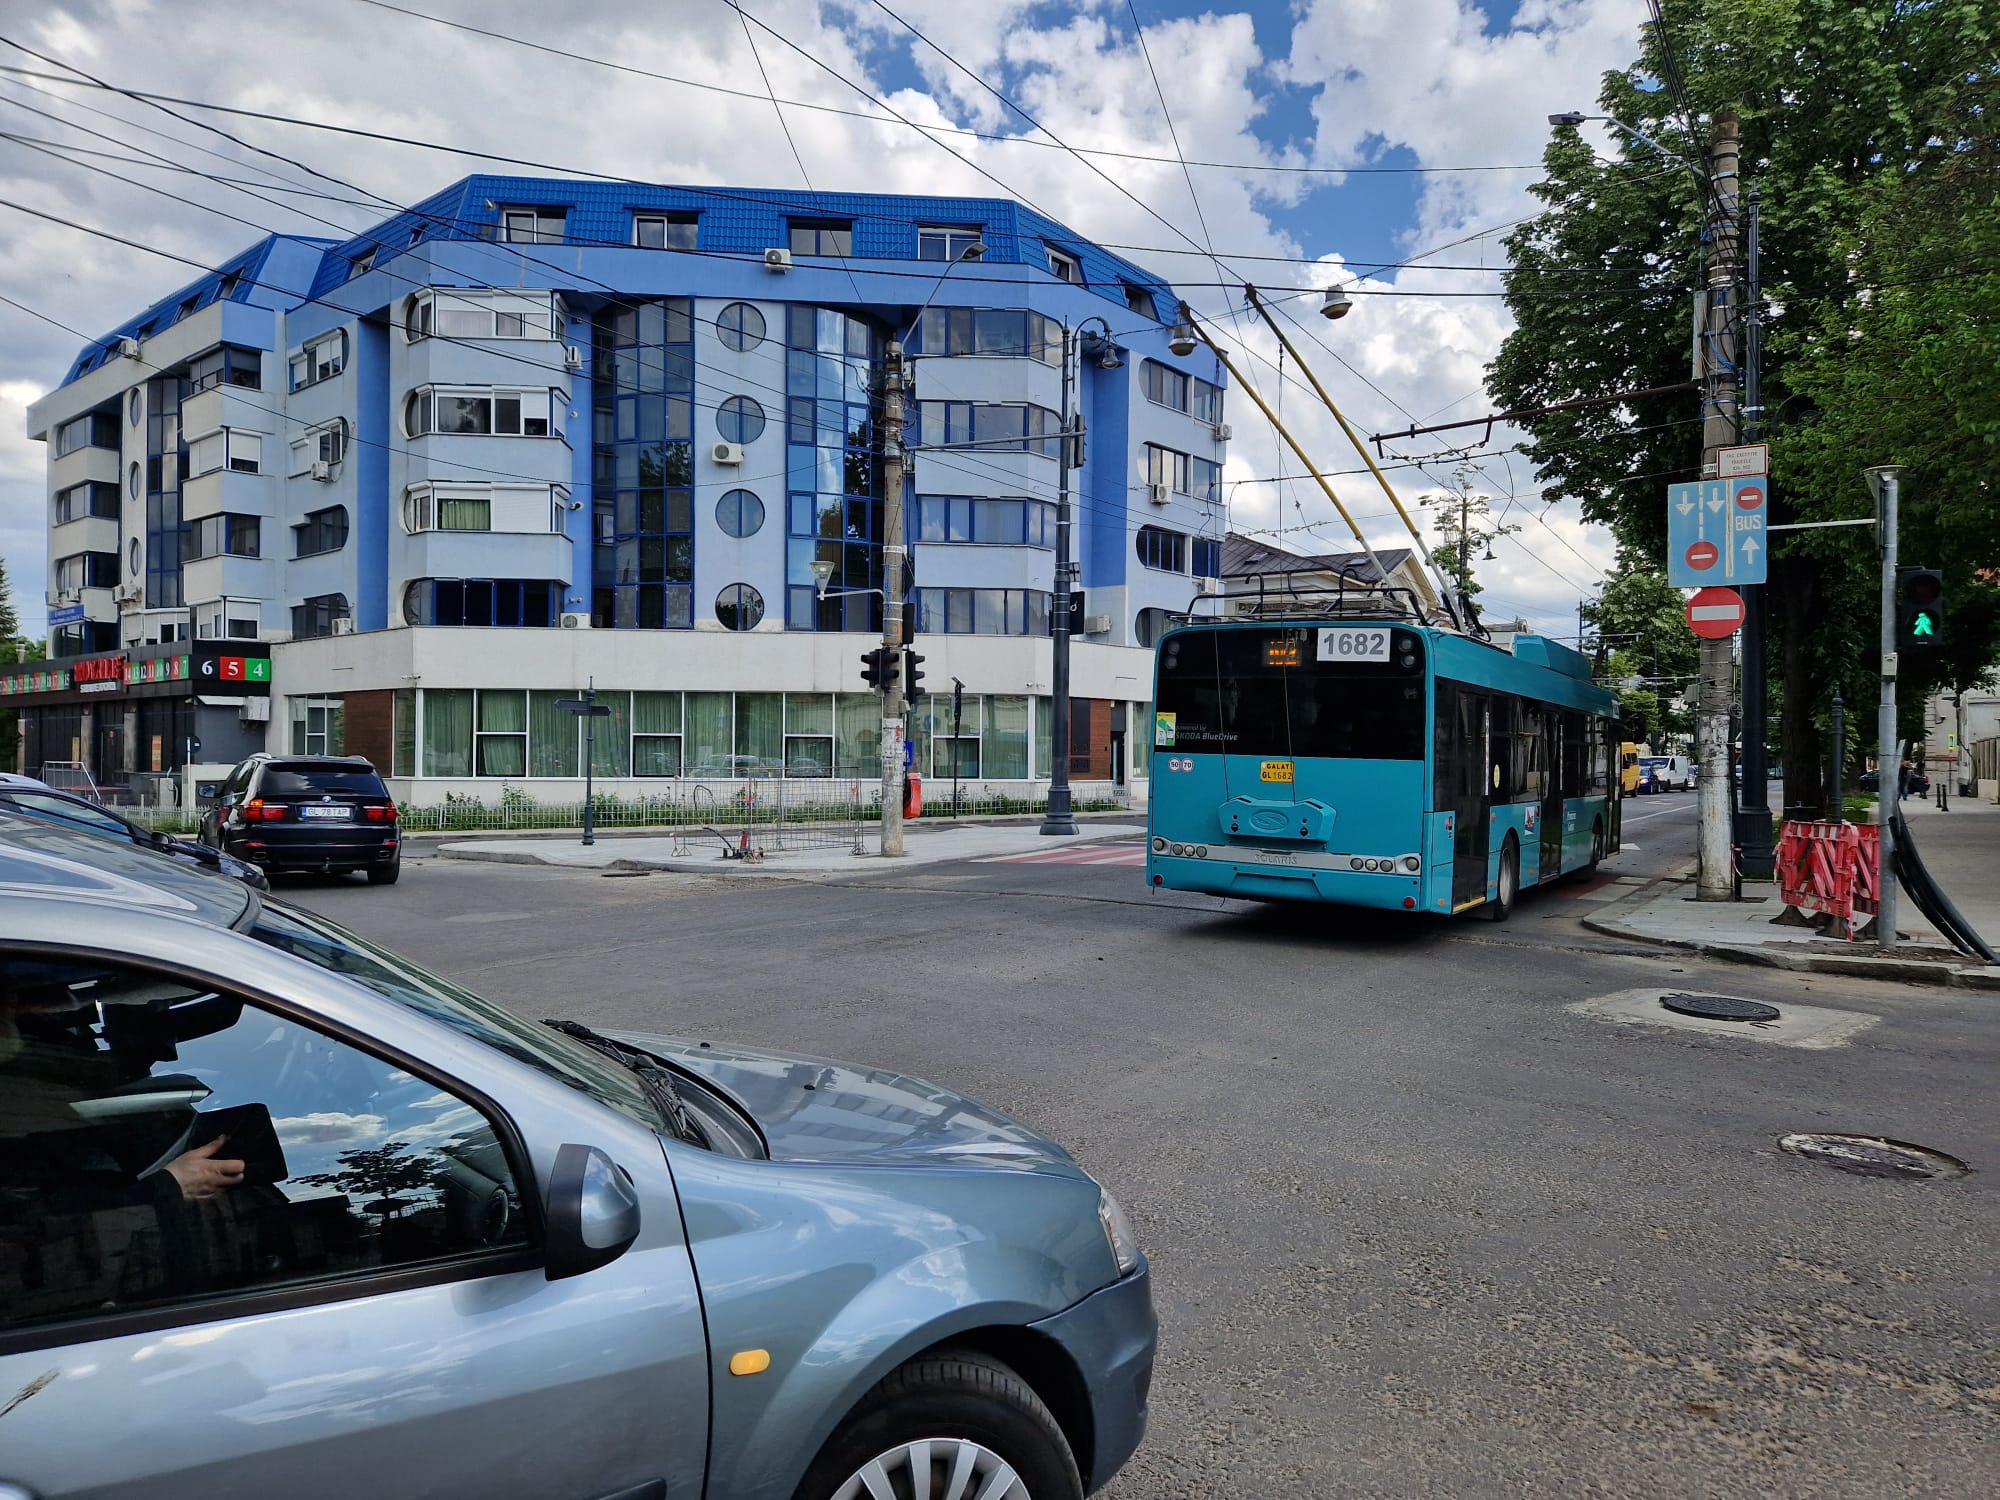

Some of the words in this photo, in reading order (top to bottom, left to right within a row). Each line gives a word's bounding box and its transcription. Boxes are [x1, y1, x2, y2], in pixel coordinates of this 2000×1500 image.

[1735, 514, 1762, 531] BUS
[1323, 633, 1385, 656] 1682
[124, 666, 131, 681] 14
[133, 665, 140, 680] 13
[140, 664, 147, 680] 12
[148, 664, 155, 679] 11
[156, 663, 163, 678] 10
[165, 662, 170, 677] 9
[173, 661, 179, 675] 8
[182, 660, 187, 674] 7
[201, 660, 213, 675] 6
[227, 661, 239, 676] 5
[253, 663, 264, 677] 4
[1202, 732, 1238, 741] BlueDrive
[1262, 771, 1272, 779] GL
[1273, 772, 1292, 780] 1682
[308, 808, 319, 816] GL
[1255, 854, 1297, 865] SOLARIS
